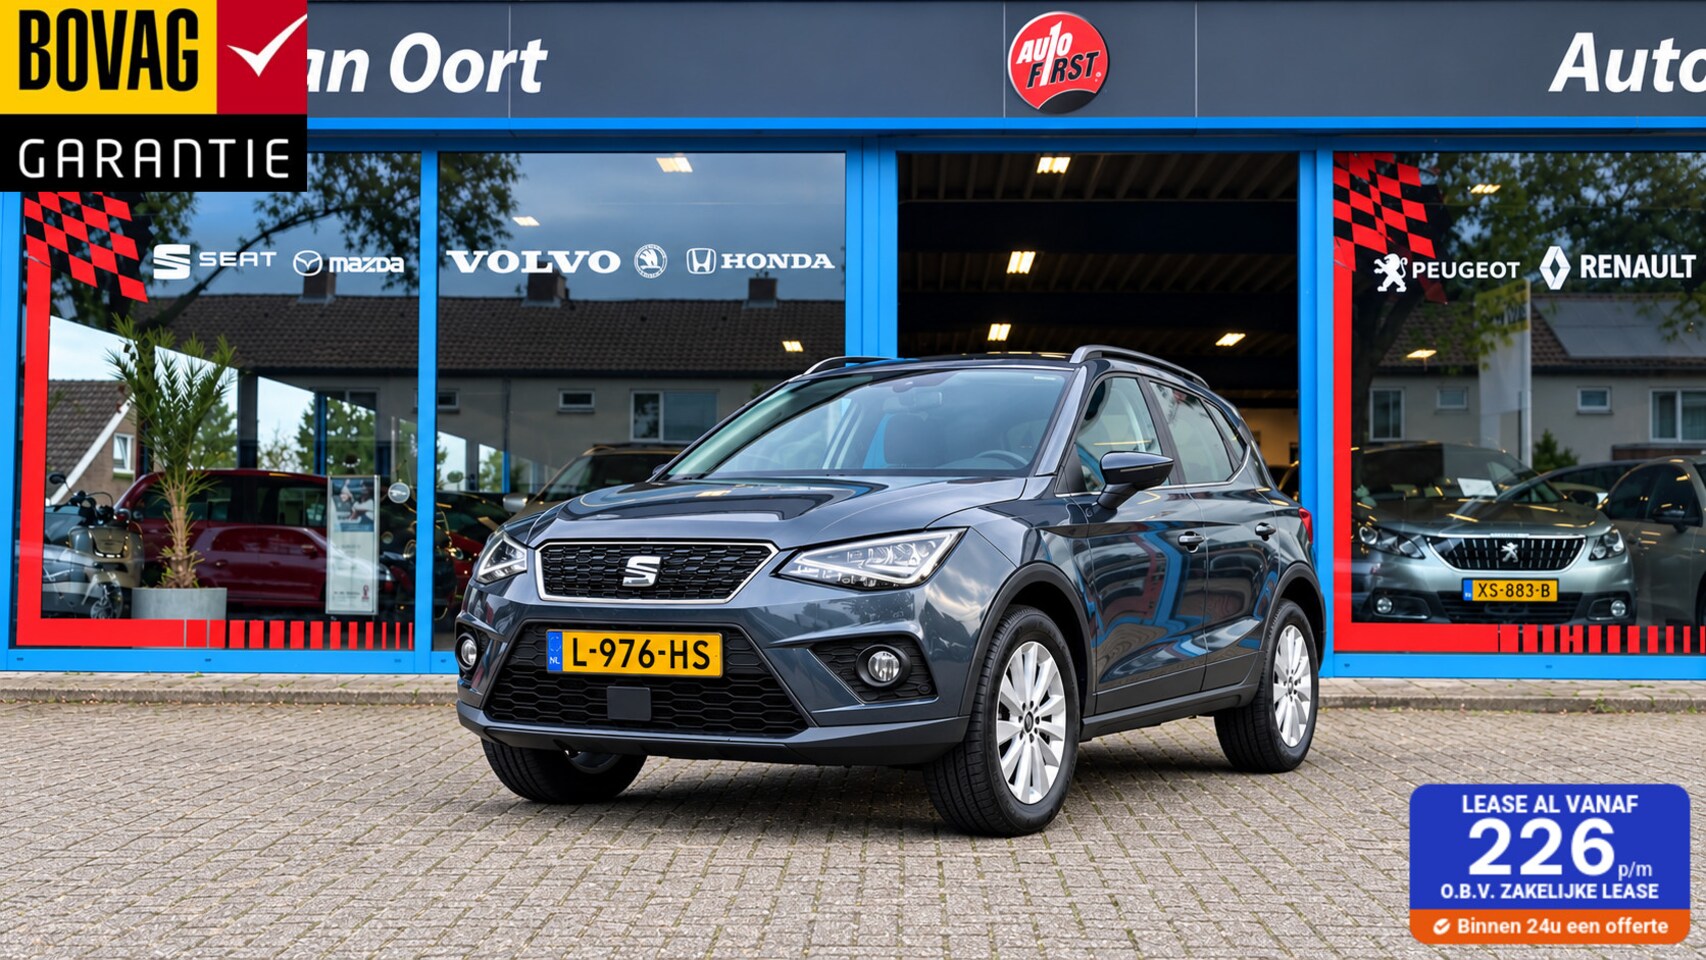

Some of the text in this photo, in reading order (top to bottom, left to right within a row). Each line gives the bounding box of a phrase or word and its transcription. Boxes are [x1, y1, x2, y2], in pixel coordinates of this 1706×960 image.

[389, 31, 549, 94] Oort
[1548, 32, 1706, 93] Auto
[199, 251, 277, 267] SEAT
[445, 249, 622, 274] VOLVO
[721, 252, 836, 270] HONDA
[1411, 261, 1521, 280] PEUGEOT
[1580, 253, 1697, 279] RENAULT
[1477, 582, 1551, 598] XS-883-B
[572, 637, 711, 670] L-976-HS
